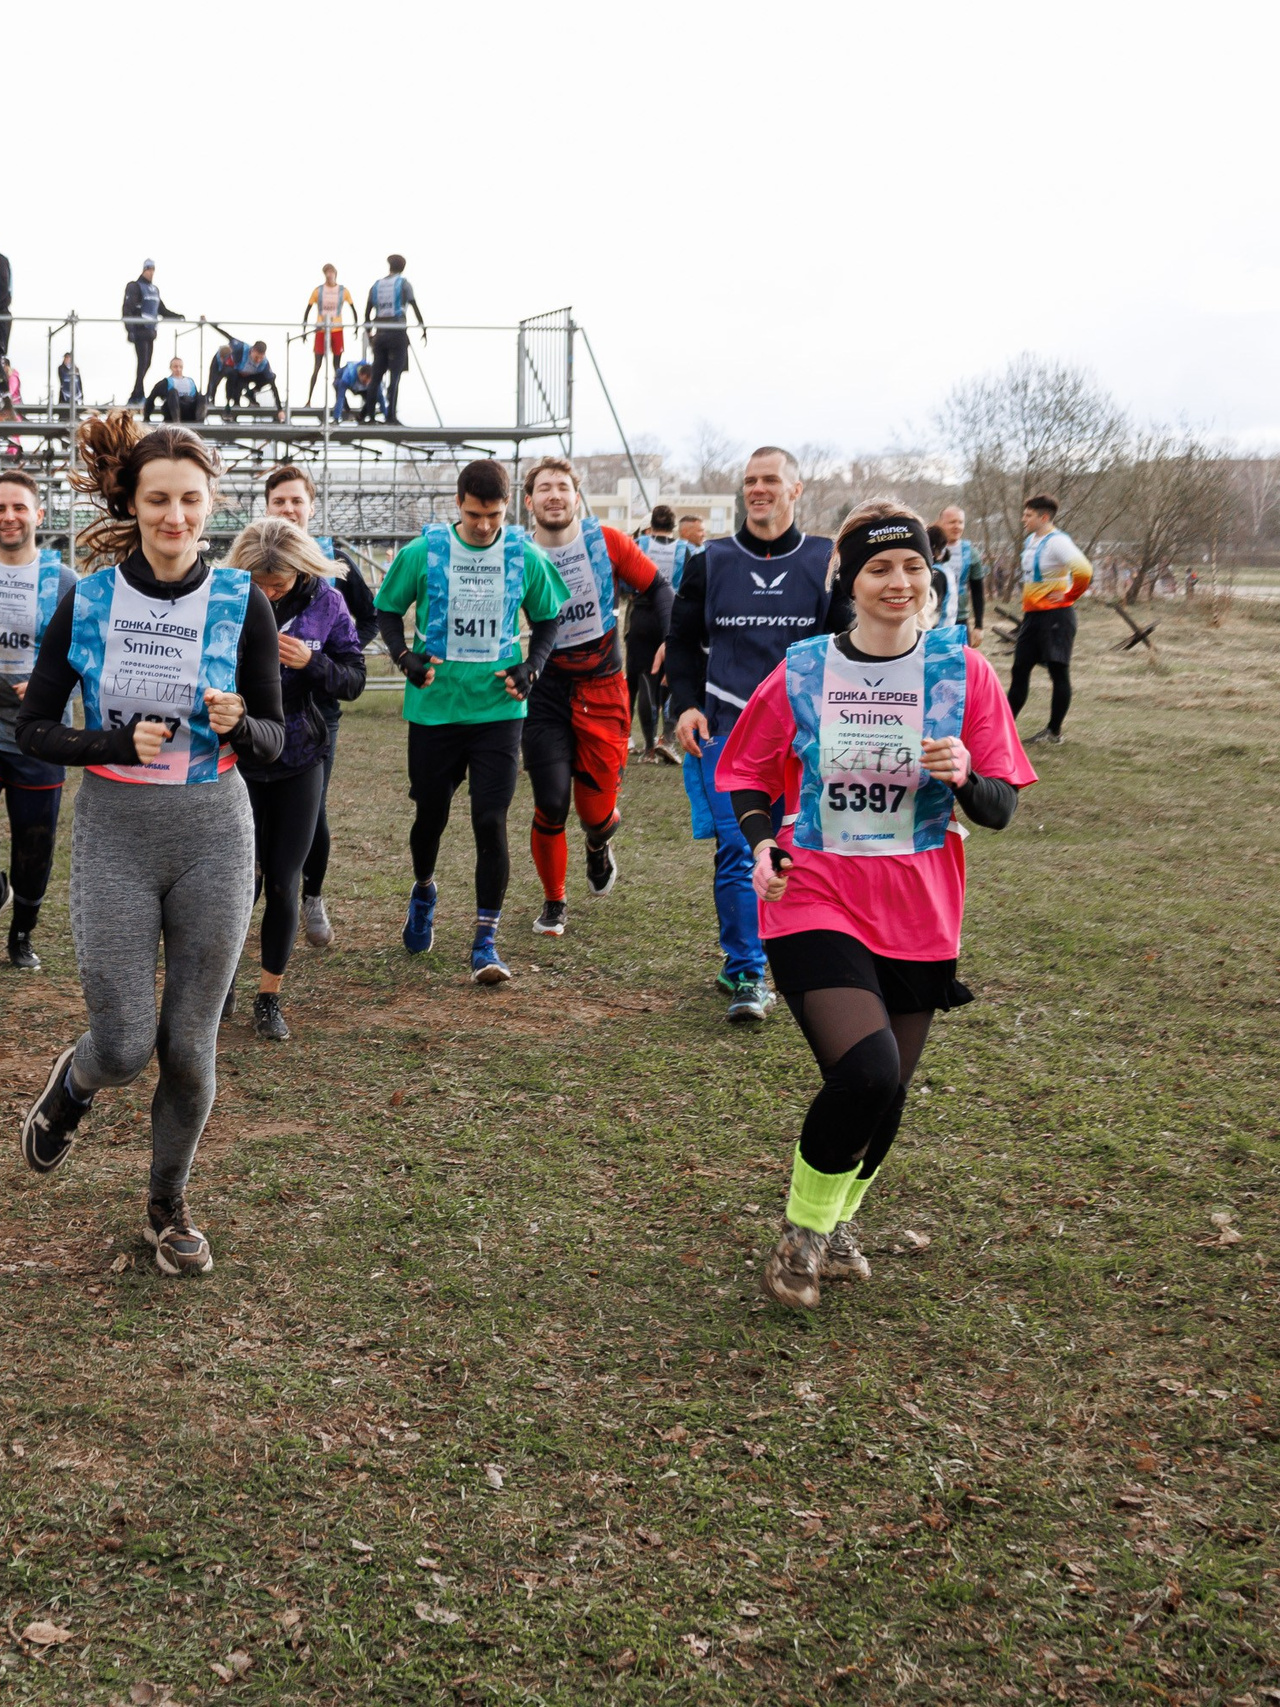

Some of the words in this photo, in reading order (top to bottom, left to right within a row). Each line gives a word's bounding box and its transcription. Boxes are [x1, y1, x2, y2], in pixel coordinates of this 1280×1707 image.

[869, 525, 908, 538] Sminex
[876, 532, 904, 542] team
[559, 566, 581, 577] inex
[459, 576, 494, 585] Sminex
[715, 616, 816, 627] ИНСТРУКТОР
[114, 619, 152, 631] ГОНКА
[155, 623, 198, 639] ГЕРОЕВ
[454, 618, 496, 637] 5411
[123, 637, 183, 659] Sminex
[120, 660, 182, 672] ПЕРФЕКЦИОНИСТЫ
[135, 670, 180, 680] DEVELOPMENT
[828, 691, 867, 701] ГОНКА
[871, 691, 918, 702] ГЕРОЕВ
[839, 709, 904, 726] Sminex
[838, 732, 904, 740] ПЕРФЕКЦИОНИСТЫ
[855, 740, 902, 748] DEVELOPMENT
[828, 782, 907, 813] 5397
